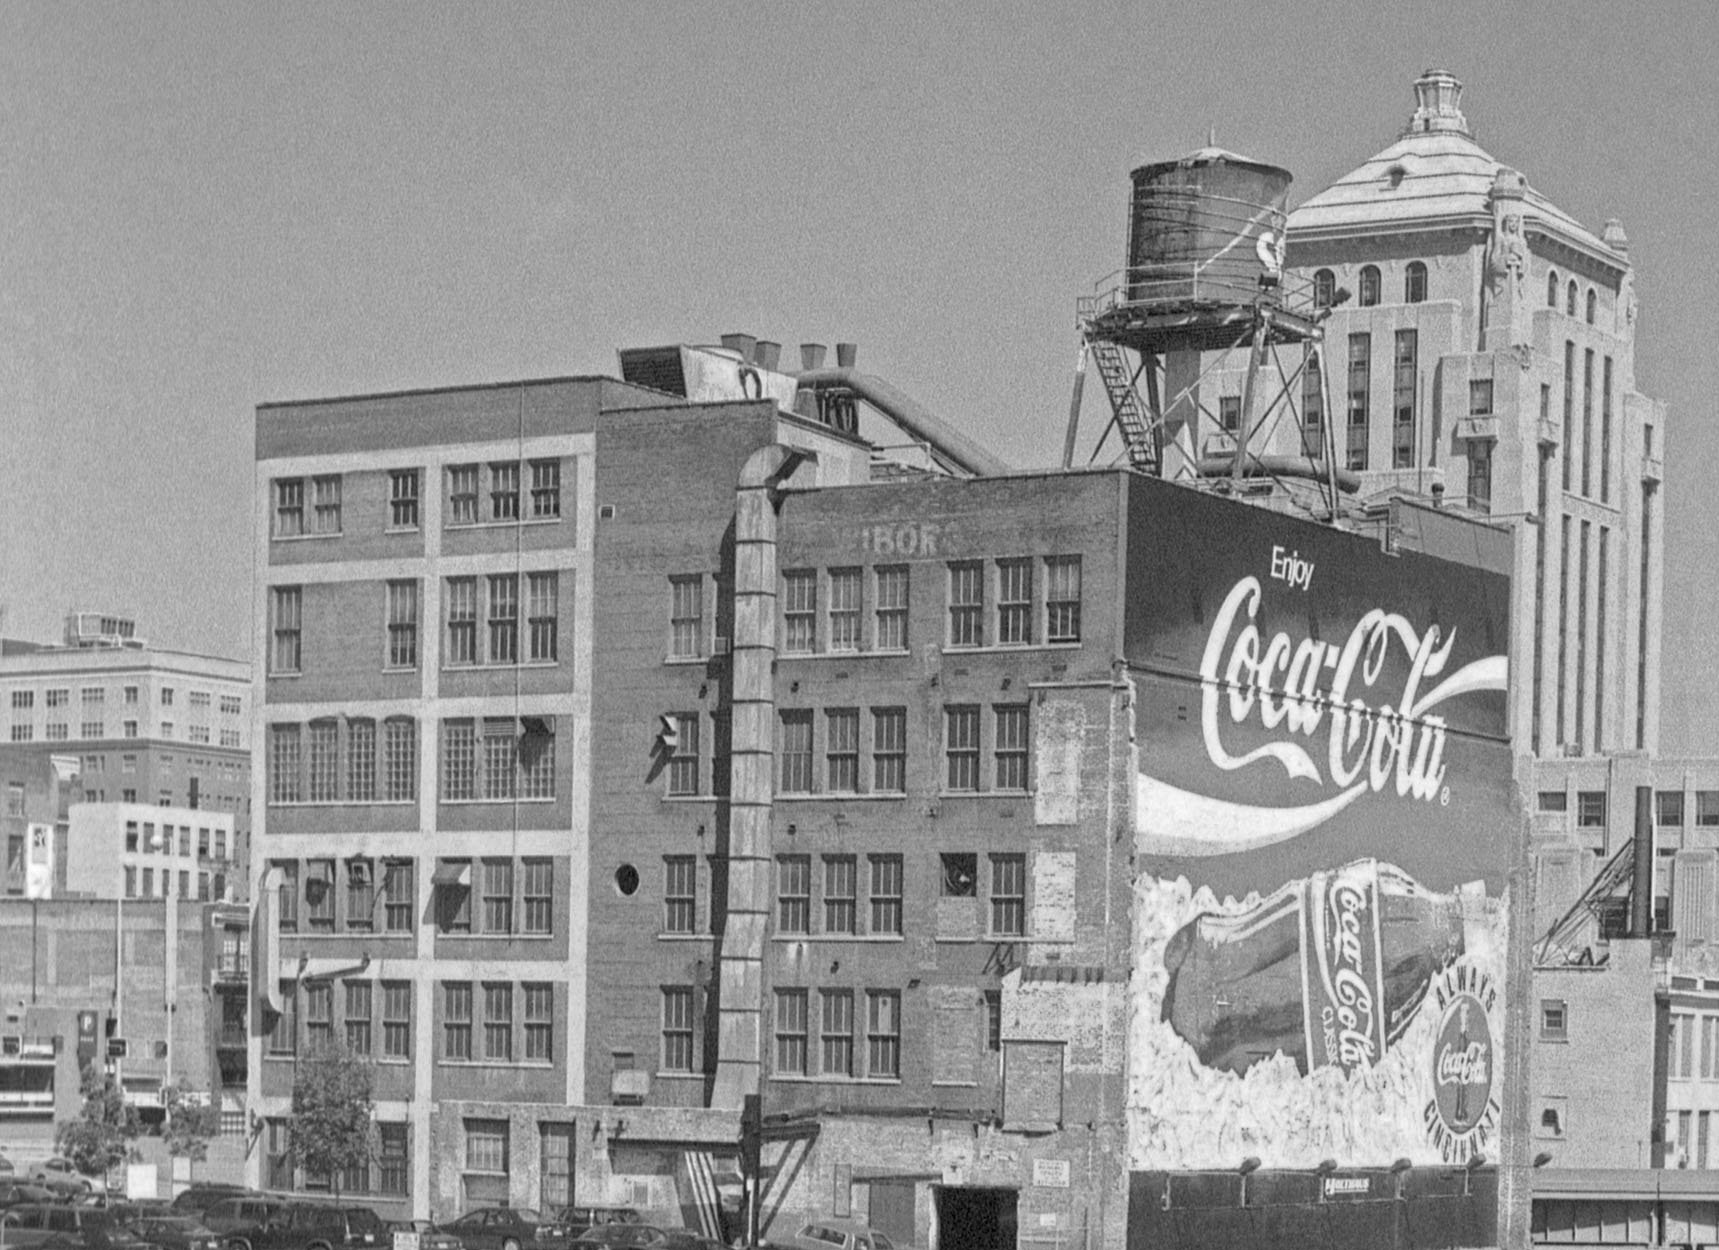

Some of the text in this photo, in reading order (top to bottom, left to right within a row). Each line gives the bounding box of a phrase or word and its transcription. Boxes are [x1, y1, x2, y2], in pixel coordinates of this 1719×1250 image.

[1271, 545, 1314, 591] Enjoy
[1200, 576, 1457, 801] Coca-Cola
[1436, 965, 1496, 1013] ALWAYS
[1424, 1098, 1500, 1163] CINCINNATI
